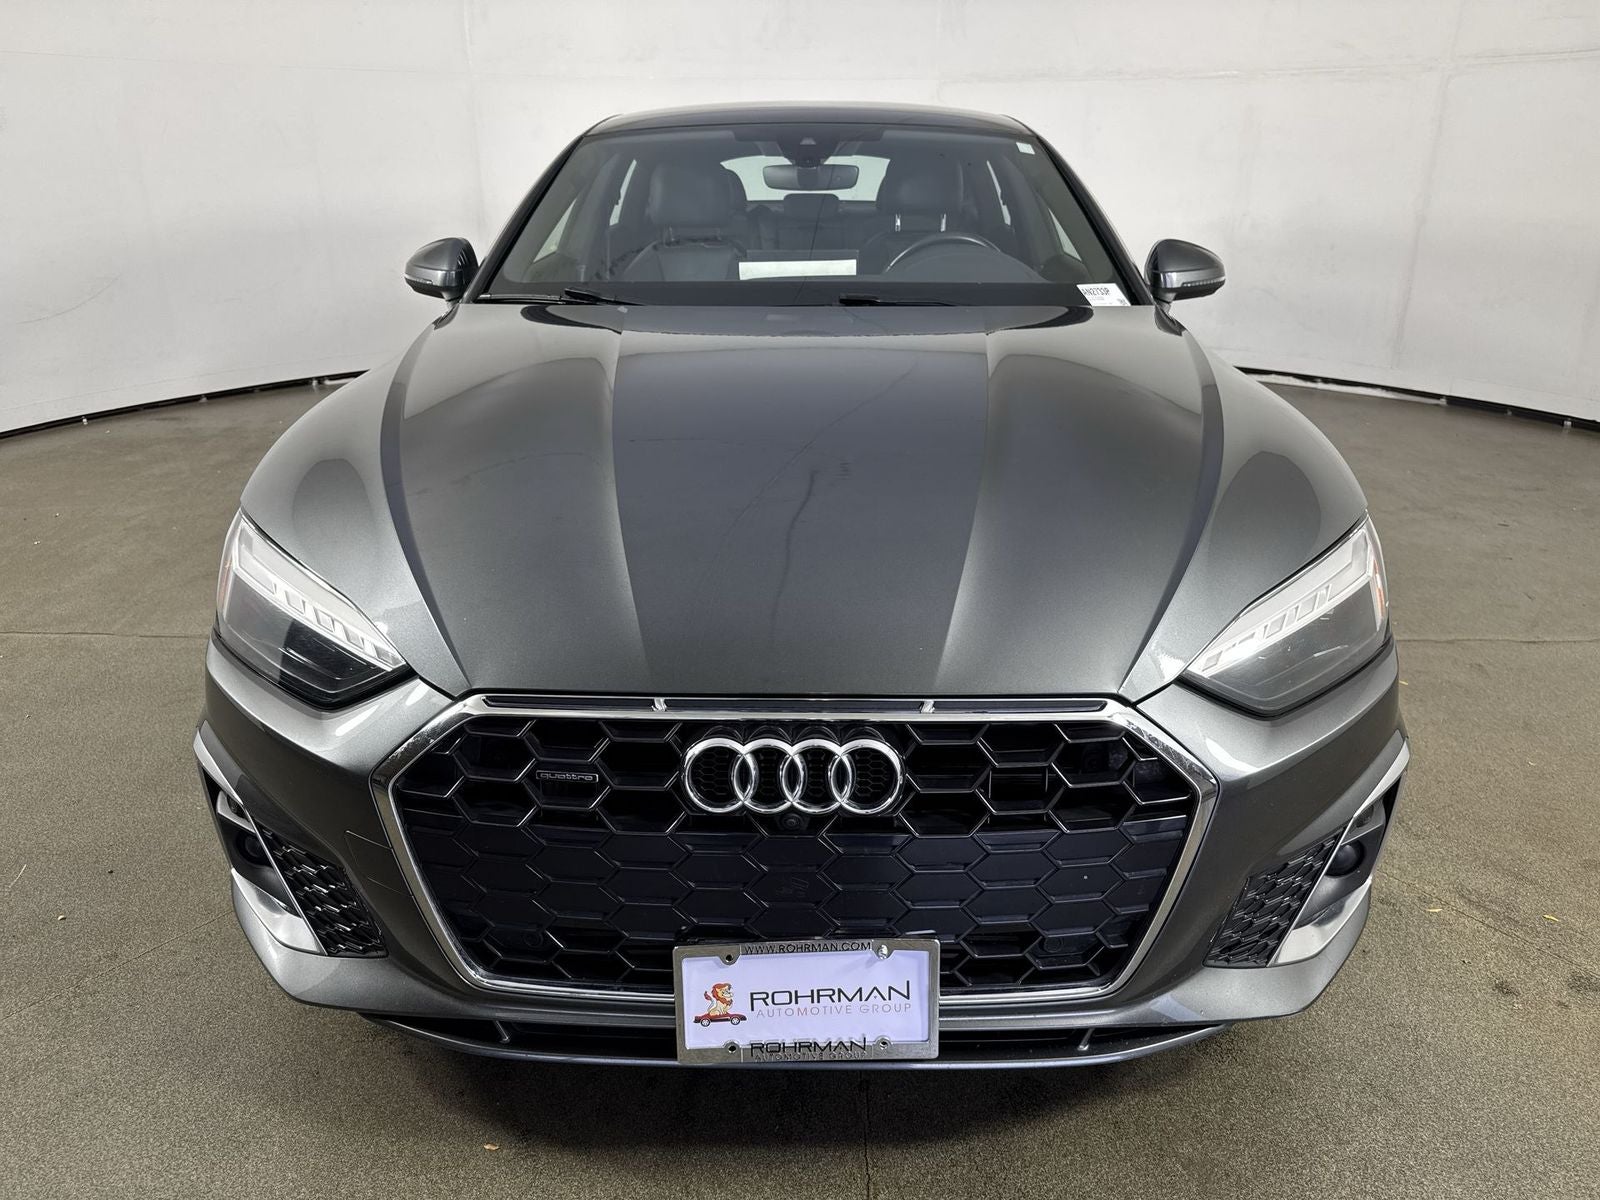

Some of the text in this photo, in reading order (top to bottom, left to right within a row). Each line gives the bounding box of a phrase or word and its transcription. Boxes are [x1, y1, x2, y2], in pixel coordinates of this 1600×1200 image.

[540, 772, 594, 781] quattro
[744, 942, 871, 954] WWW.ROHRMAN.COM
[750, 980, 910, 1011] ROHRMAN
[756, 1002, 912, 1018] AUTOMOTIVE GROUP
[751, 1037, 866, 1057] ROHRMAN
